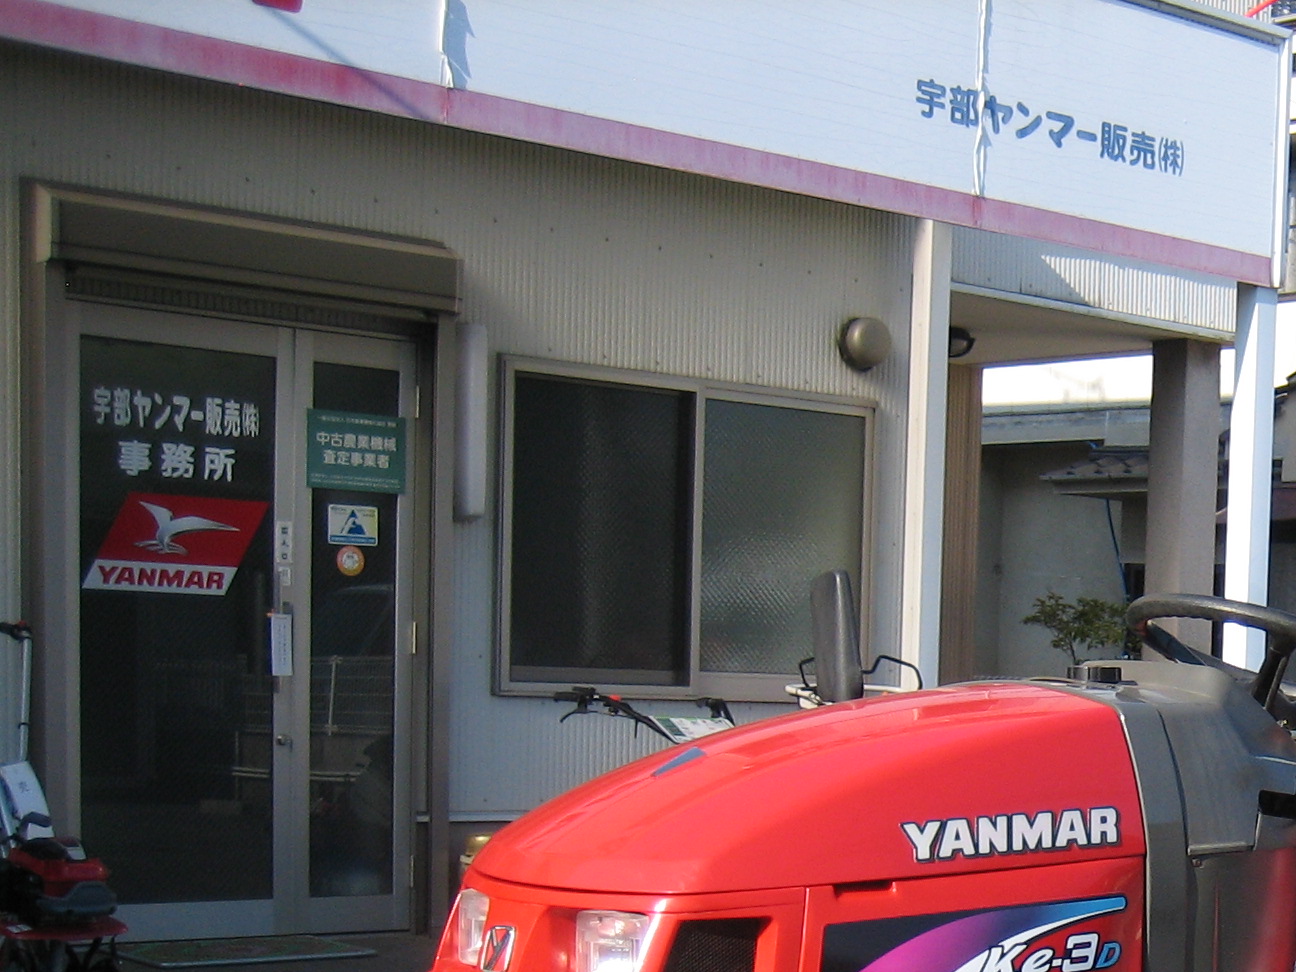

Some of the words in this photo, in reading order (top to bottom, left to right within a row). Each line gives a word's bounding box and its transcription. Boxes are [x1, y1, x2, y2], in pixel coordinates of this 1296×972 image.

[118, 440, 236, 482] 事務所
[98, 565, 225, 591] YANMAR
[902, 806, 1119, 863] YANMAR
